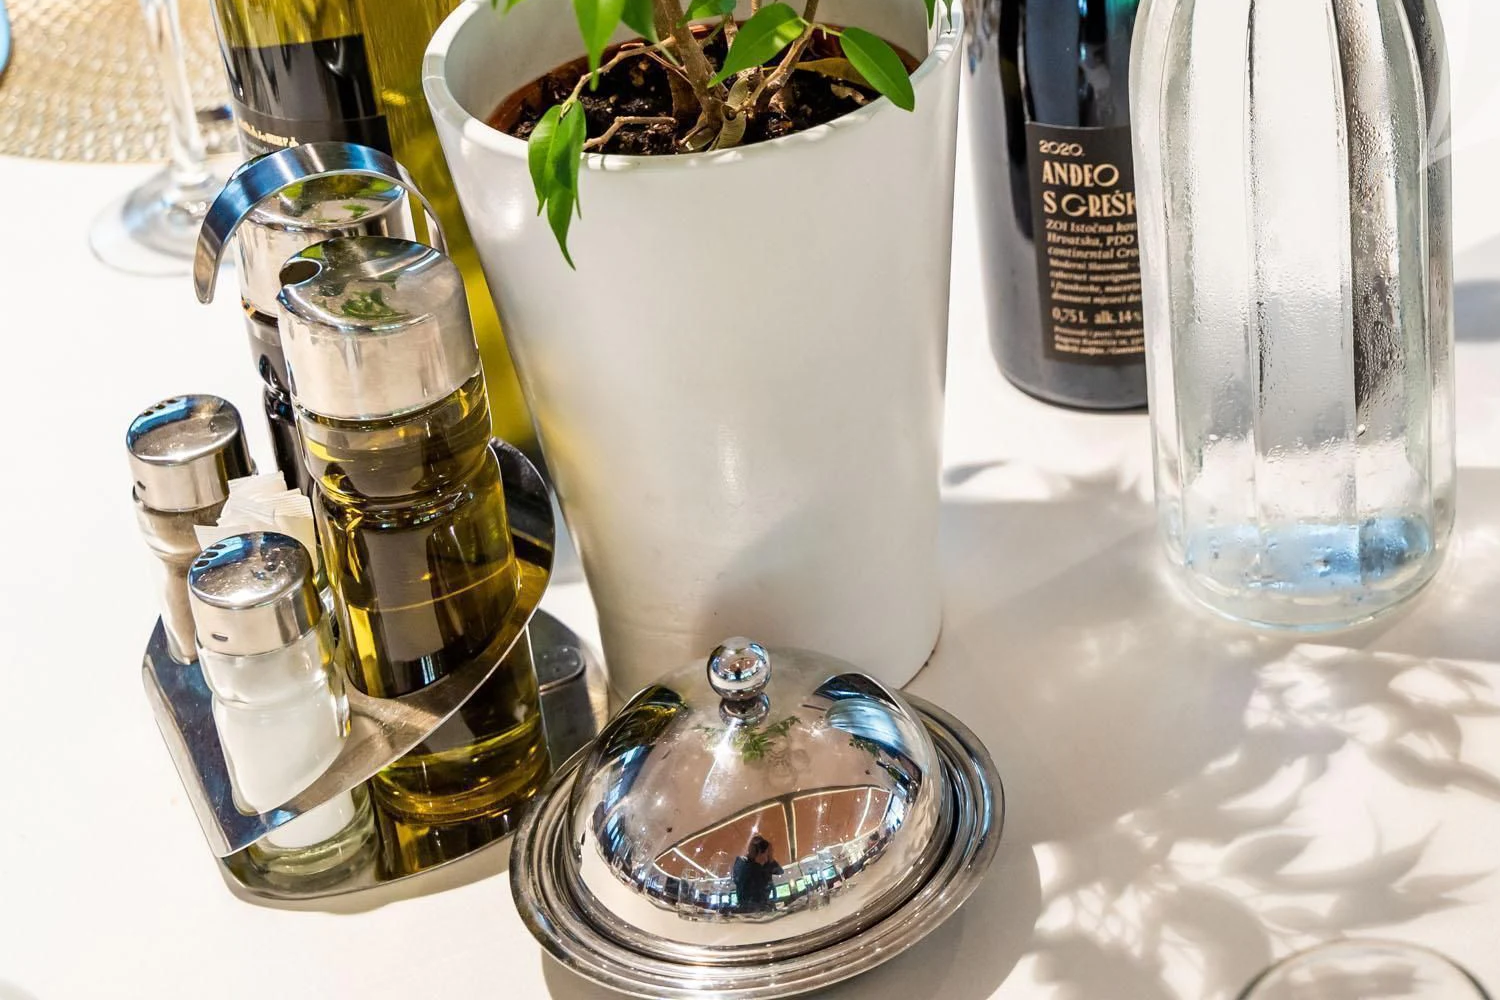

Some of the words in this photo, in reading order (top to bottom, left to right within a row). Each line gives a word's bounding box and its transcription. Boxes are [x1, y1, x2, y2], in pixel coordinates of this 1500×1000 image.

[1039, 140, 1085, 157] 2020.
[1043, 190, 1057, 214] S
[1106, 234, 1135, 246] PDO
